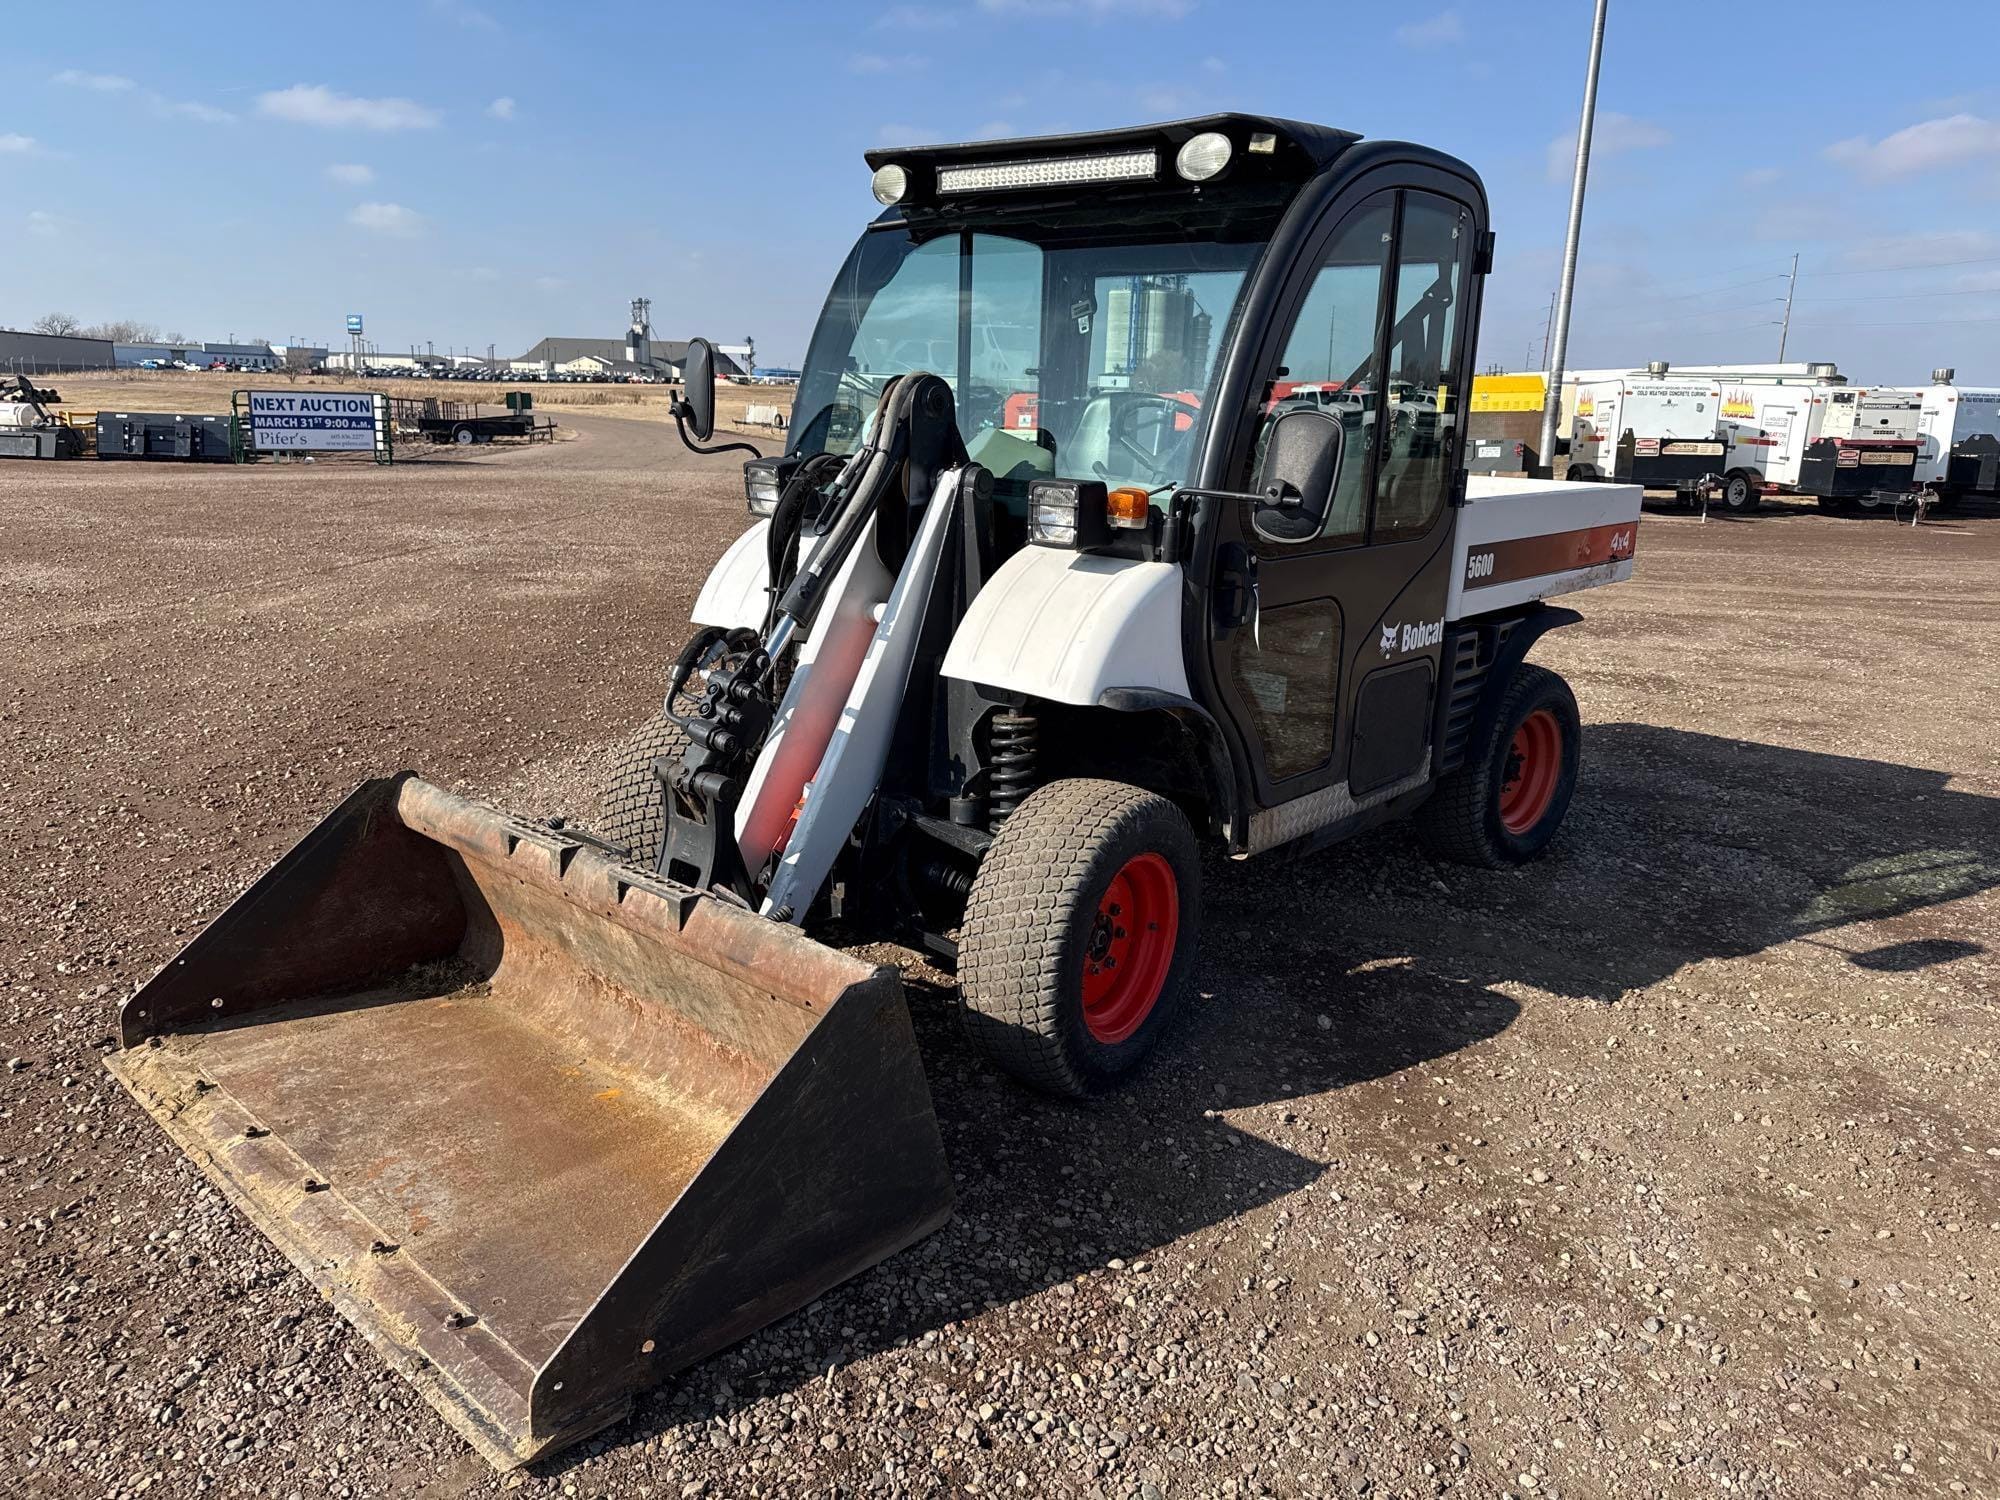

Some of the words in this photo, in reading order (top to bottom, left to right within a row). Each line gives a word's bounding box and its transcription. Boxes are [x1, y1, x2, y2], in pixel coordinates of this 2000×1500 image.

[253, 398, 296, 411] NEXT
[299, 399, 370, 413] AUCTION
[254, 417, 298, 428] MARCH
[300, 417, 322, 428] 31ST
[324, 418, 349, 428] 9:00
[351, 420, 371, 429] A.M.
[259, 431, 308, 446] Pifer's
[1610, 530, 1630, 552] 4x4
[1467, 552, 1495, 579] 5600
[1400, 616, 1444, 653] Bobcat
